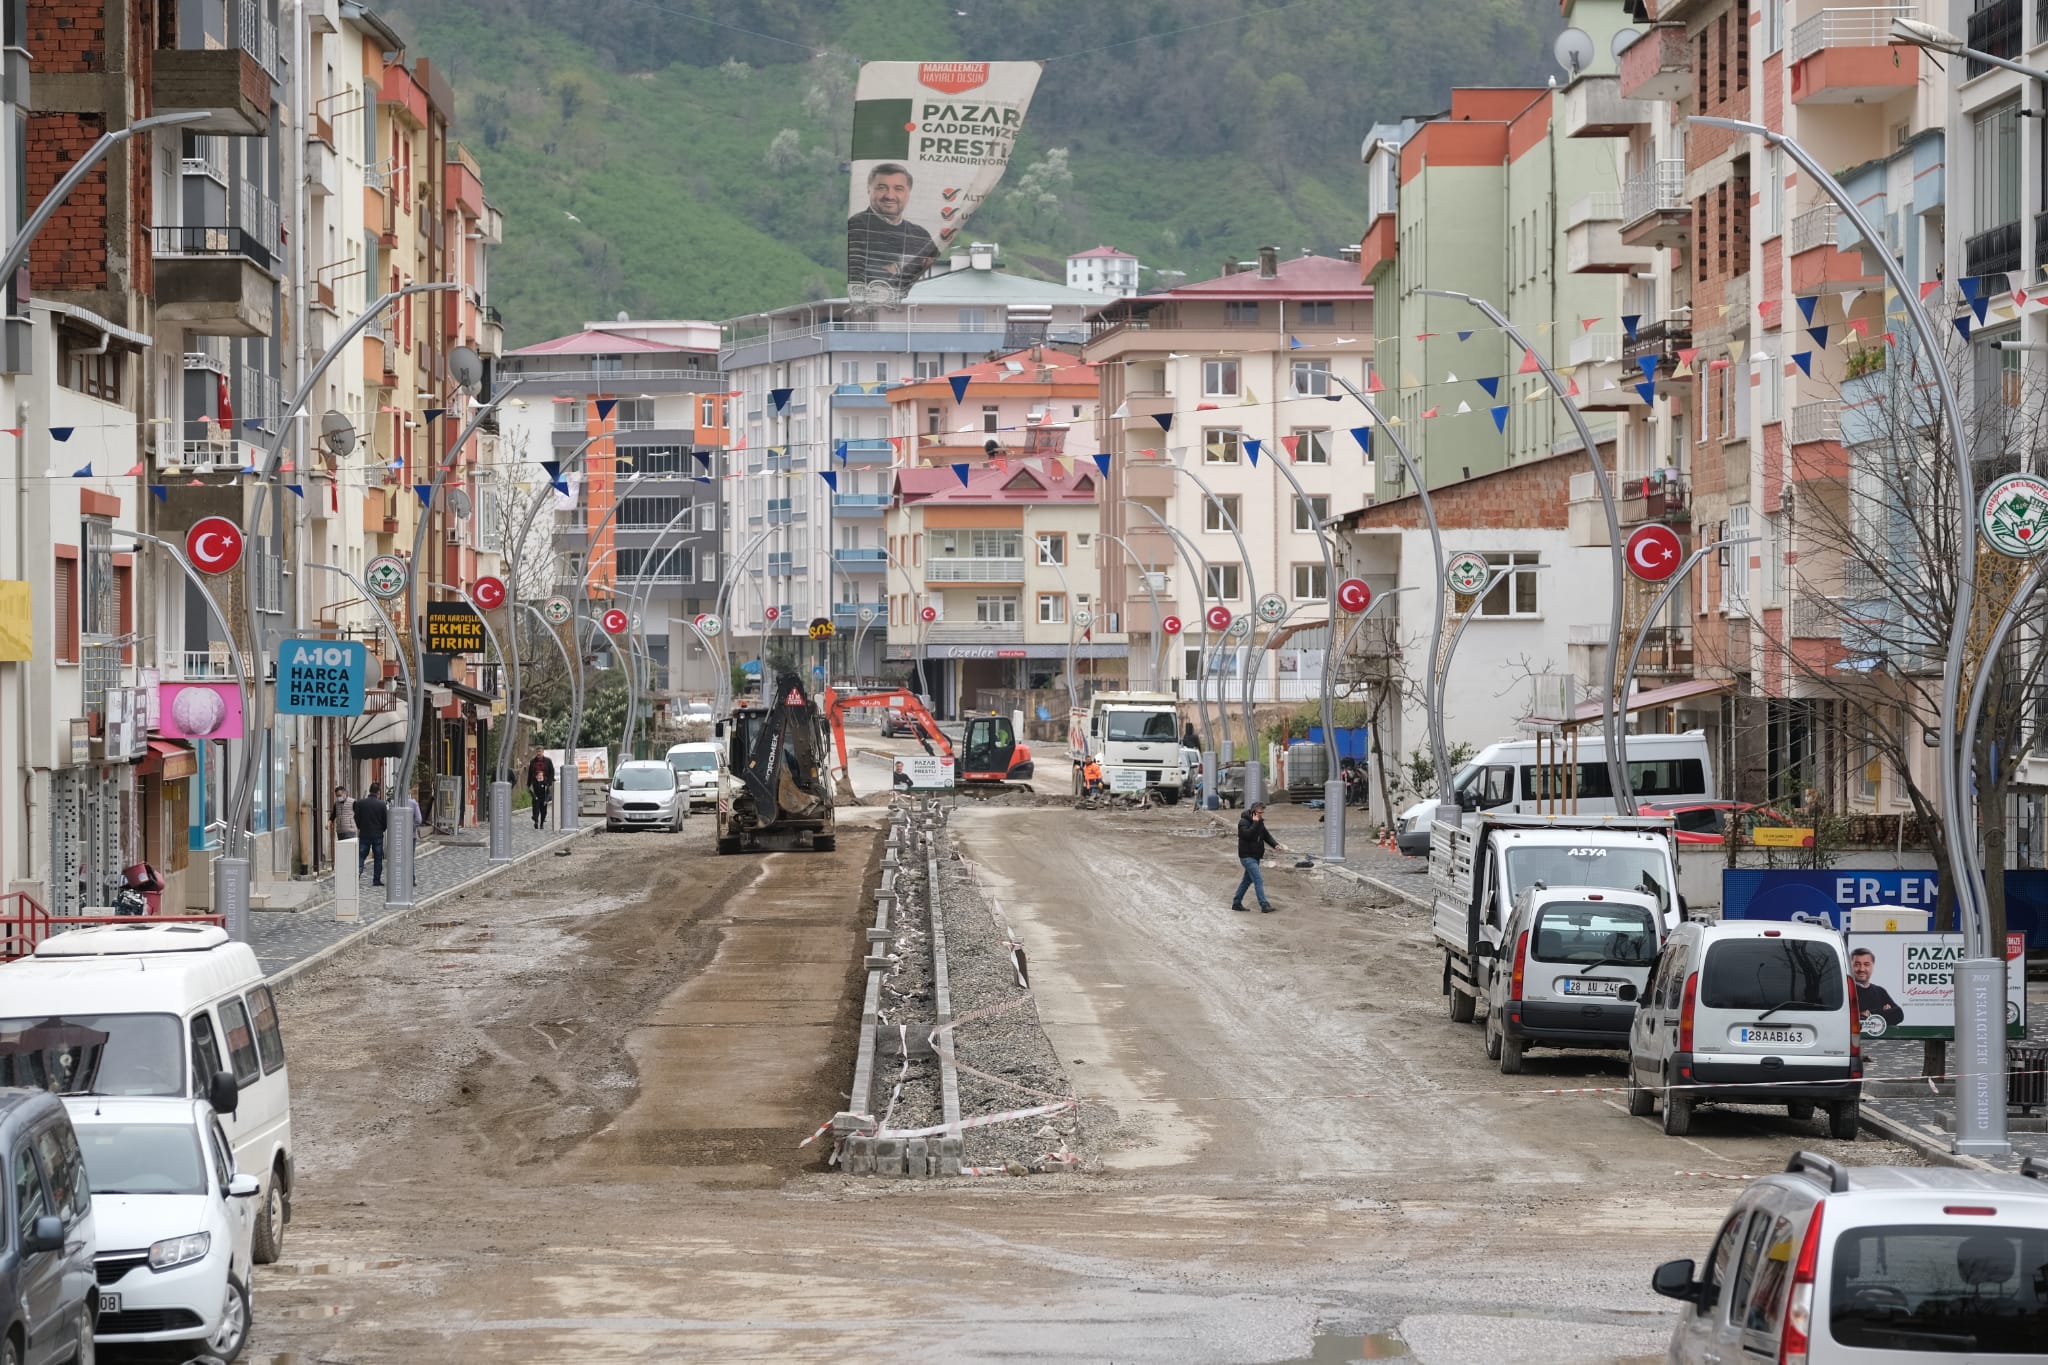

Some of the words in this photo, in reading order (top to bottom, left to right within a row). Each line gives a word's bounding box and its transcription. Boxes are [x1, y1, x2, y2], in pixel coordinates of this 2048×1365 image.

[957, 72, 985, 83] OLSUN
[923, 104, 1020, 127] PAZAR
[429, 623, 482, 635] EKMEK
[432, 637, 480, 650] FIRINI
[291, 667, 350, 681] HARCA
[291, 681, 349, 694] HARCA
[1567, 848, 1608, 857] ASYA
[1570, 981, 1581, 991] 28
[1748, 1030, 1803, 1043] 28AAB163
[100, 1296, 116, 1310] 08
